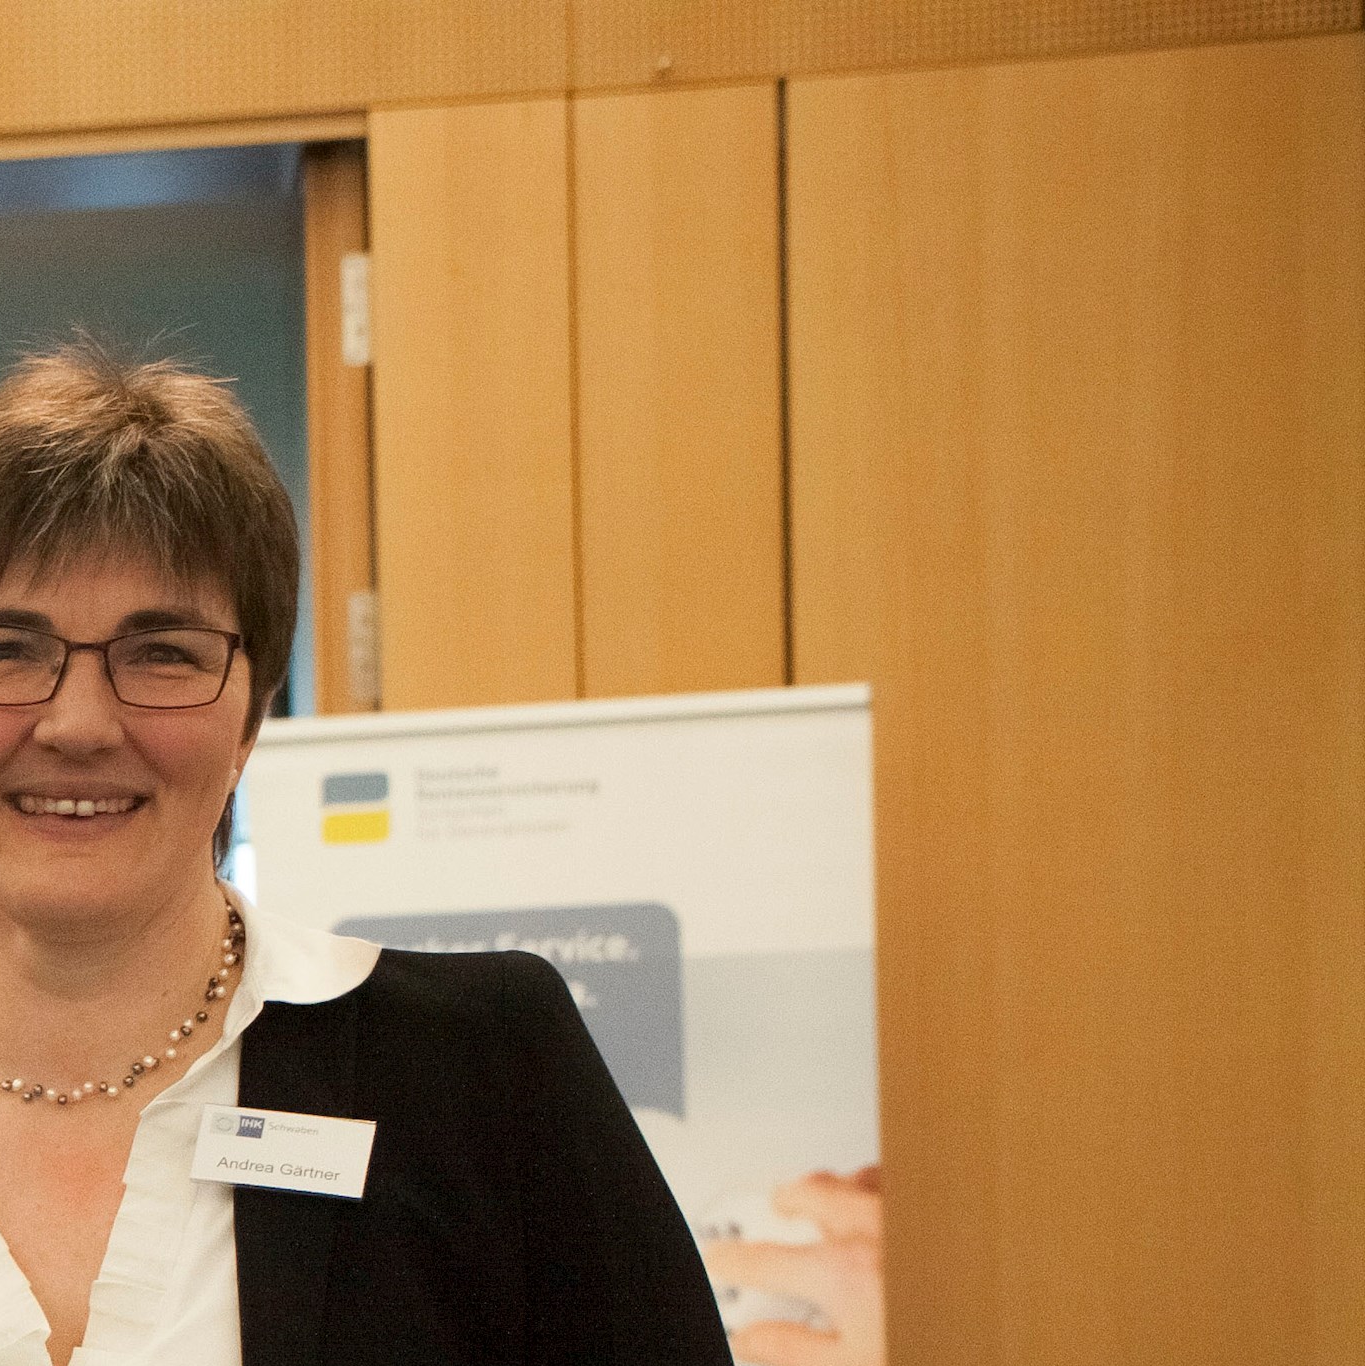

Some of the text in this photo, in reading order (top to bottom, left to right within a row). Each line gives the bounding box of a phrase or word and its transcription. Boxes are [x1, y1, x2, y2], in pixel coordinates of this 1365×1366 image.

[240, 1118, 319, 1135] IHK Schwaben
[217, 1156, 340, 1181] Andrea Gärtner
